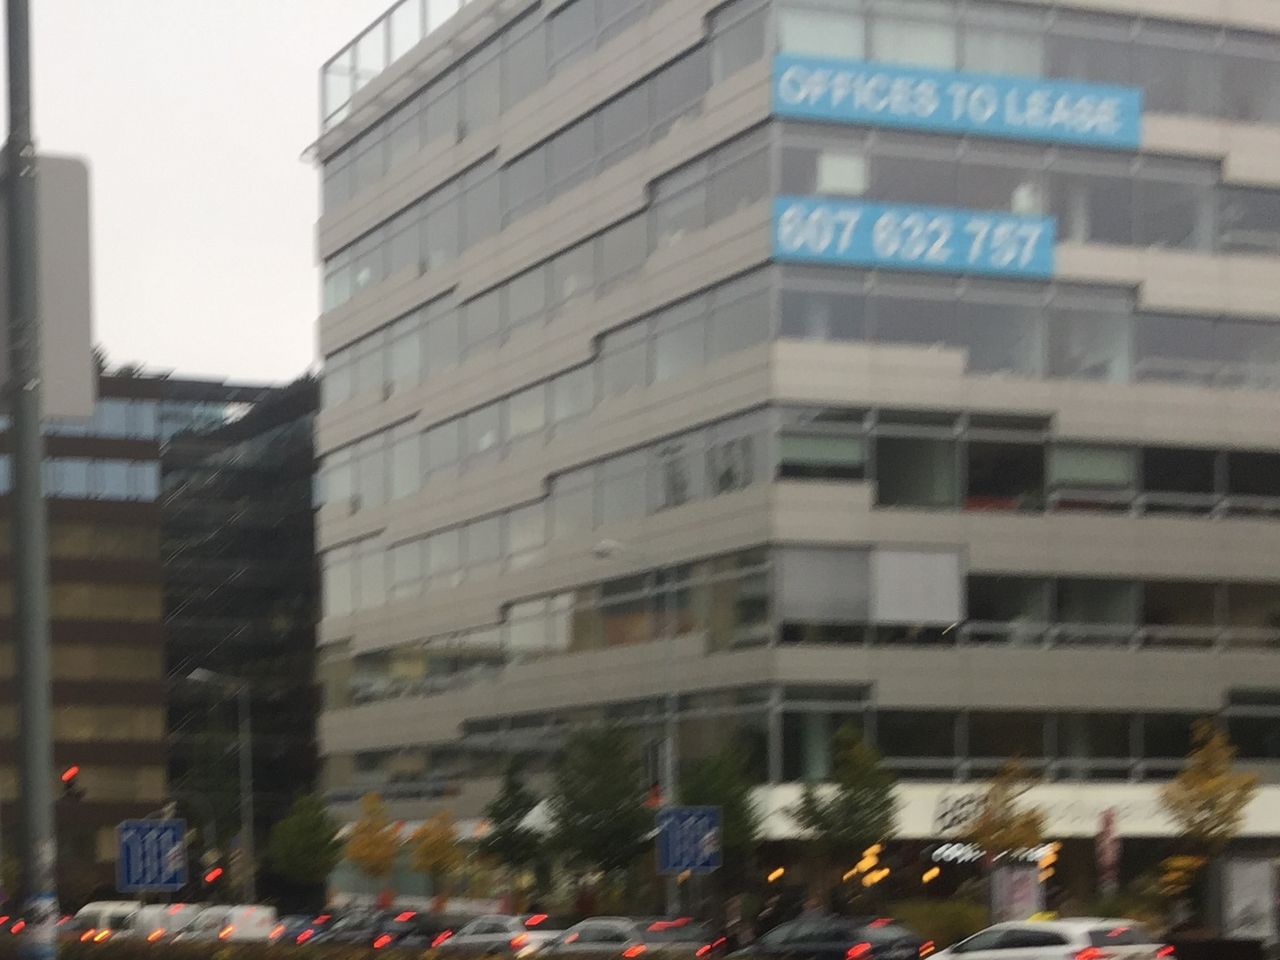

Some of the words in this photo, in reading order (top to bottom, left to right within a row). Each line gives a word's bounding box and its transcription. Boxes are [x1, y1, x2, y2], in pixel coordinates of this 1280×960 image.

[778, 64, 940, 118] OFFICES
[947, 82, 999, 122] TO
[1003, 88, 1123, 136] LEASE
[777, 203, 862, 254] 607
[872, 211, 953, 264] 632
